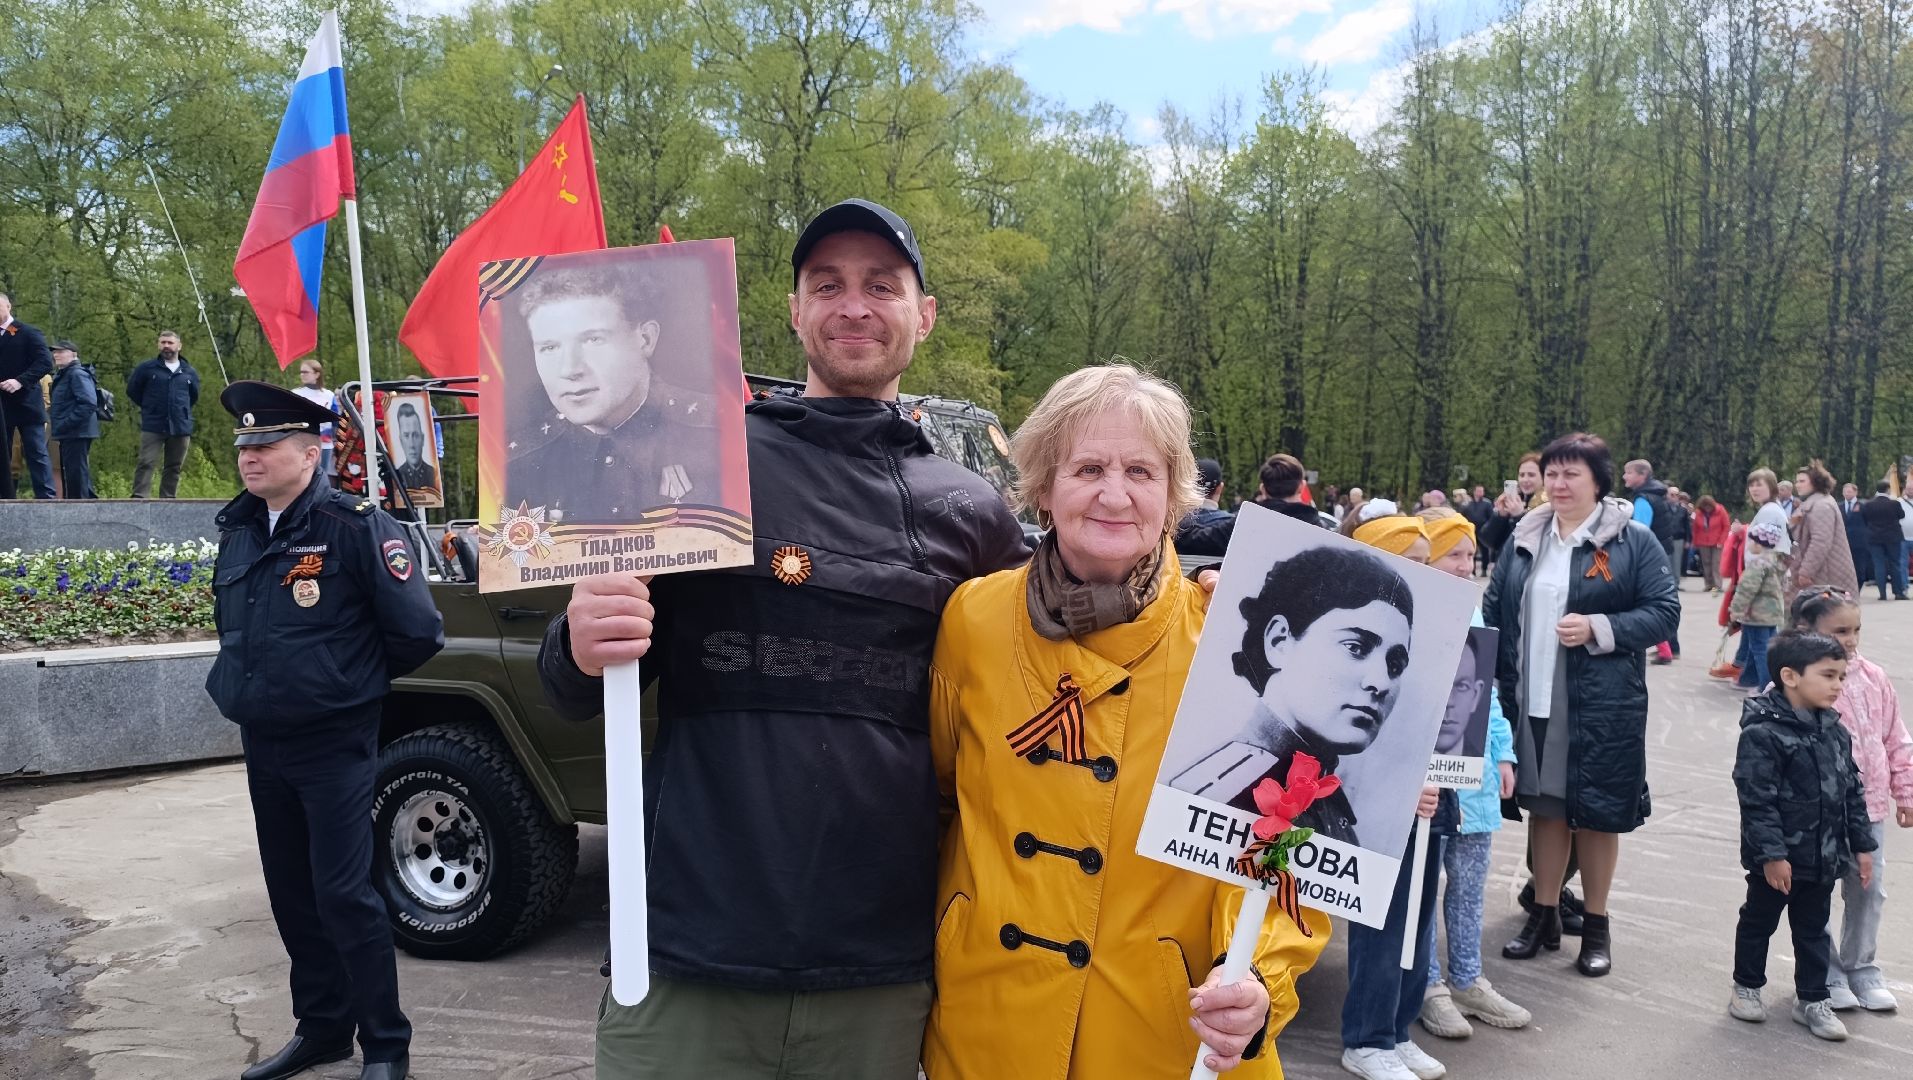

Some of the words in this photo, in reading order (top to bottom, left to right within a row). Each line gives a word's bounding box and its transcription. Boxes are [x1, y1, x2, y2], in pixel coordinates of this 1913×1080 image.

[289, 544, 328, 553] ПОЛИЦИЯ
[581, 535, 656, 557] ГЛАДКОВ
[520, 560, 610, 583] Владимир
[613, 548, 718, 573] Васильевич
[371, 770, 442, 822] All-Terrain
[1427, 774, 1482, 785] АЛЕКСЕЕВИЧ
[1164, 838, 1220, 869] АННА
[1187, 804, 1361, 885] ТЕНОВА
[398, 890, 492, 933] BFGoodrich
